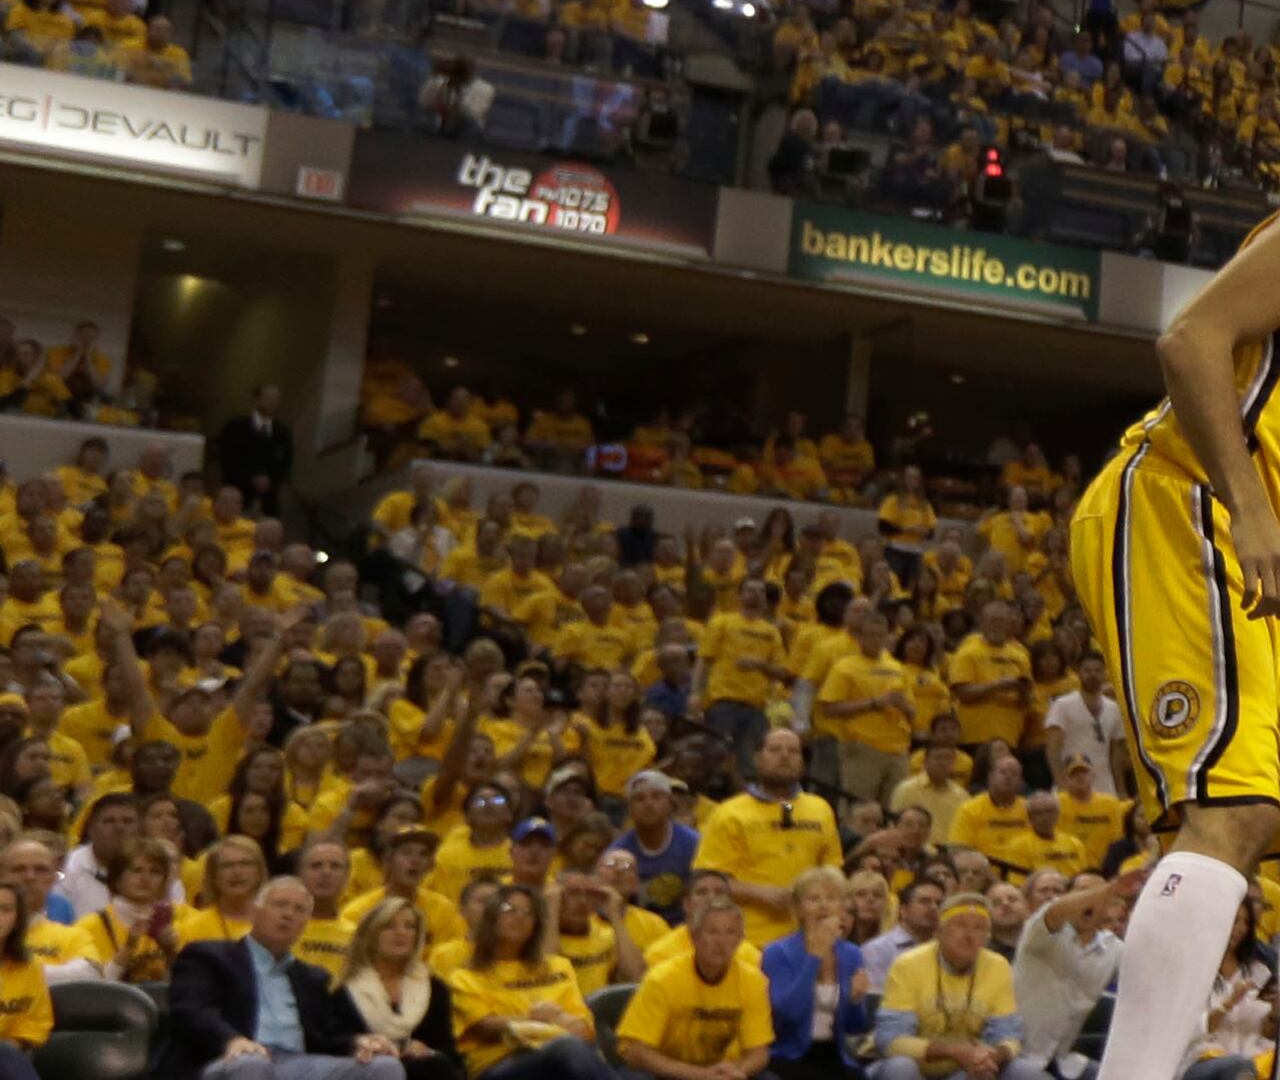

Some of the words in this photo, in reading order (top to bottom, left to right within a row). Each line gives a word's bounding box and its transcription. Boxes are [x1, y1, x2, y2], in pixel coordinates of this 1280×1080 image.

[58, 103, 260, 157] DEVAULT
[458, 153, 532, 195] the
[473, 186, 549, 226] fan
[803, 221, 1090, 299] bankerslife.com
